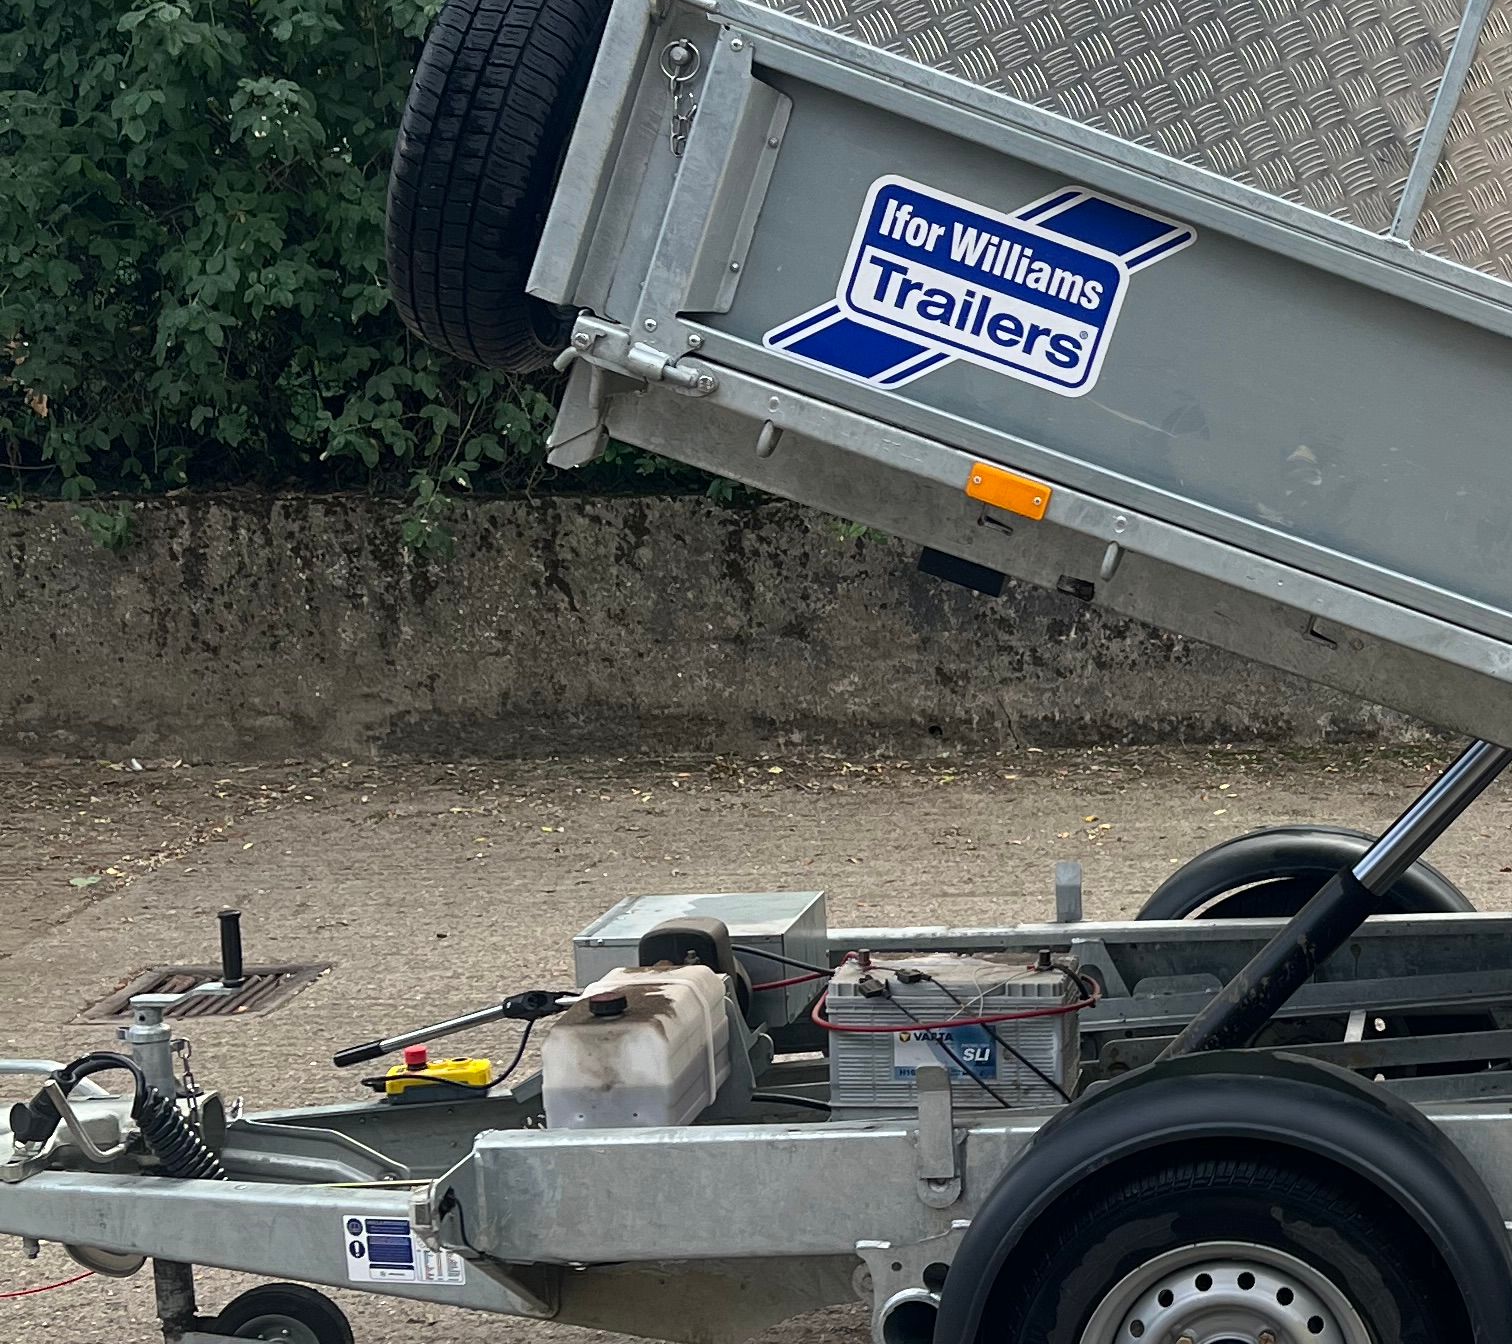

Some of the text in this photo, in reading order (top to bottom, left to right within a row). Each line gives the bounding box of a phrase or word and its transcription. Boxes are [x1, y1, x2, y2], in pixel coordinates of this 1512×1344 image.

[878, 198, 1104, 310] Ifor Williams
[869, 256, 1083, 369] Trailers
[913, 1032, 953, 1041] VARTA
[962, 1048, 991, 1062] SLI
